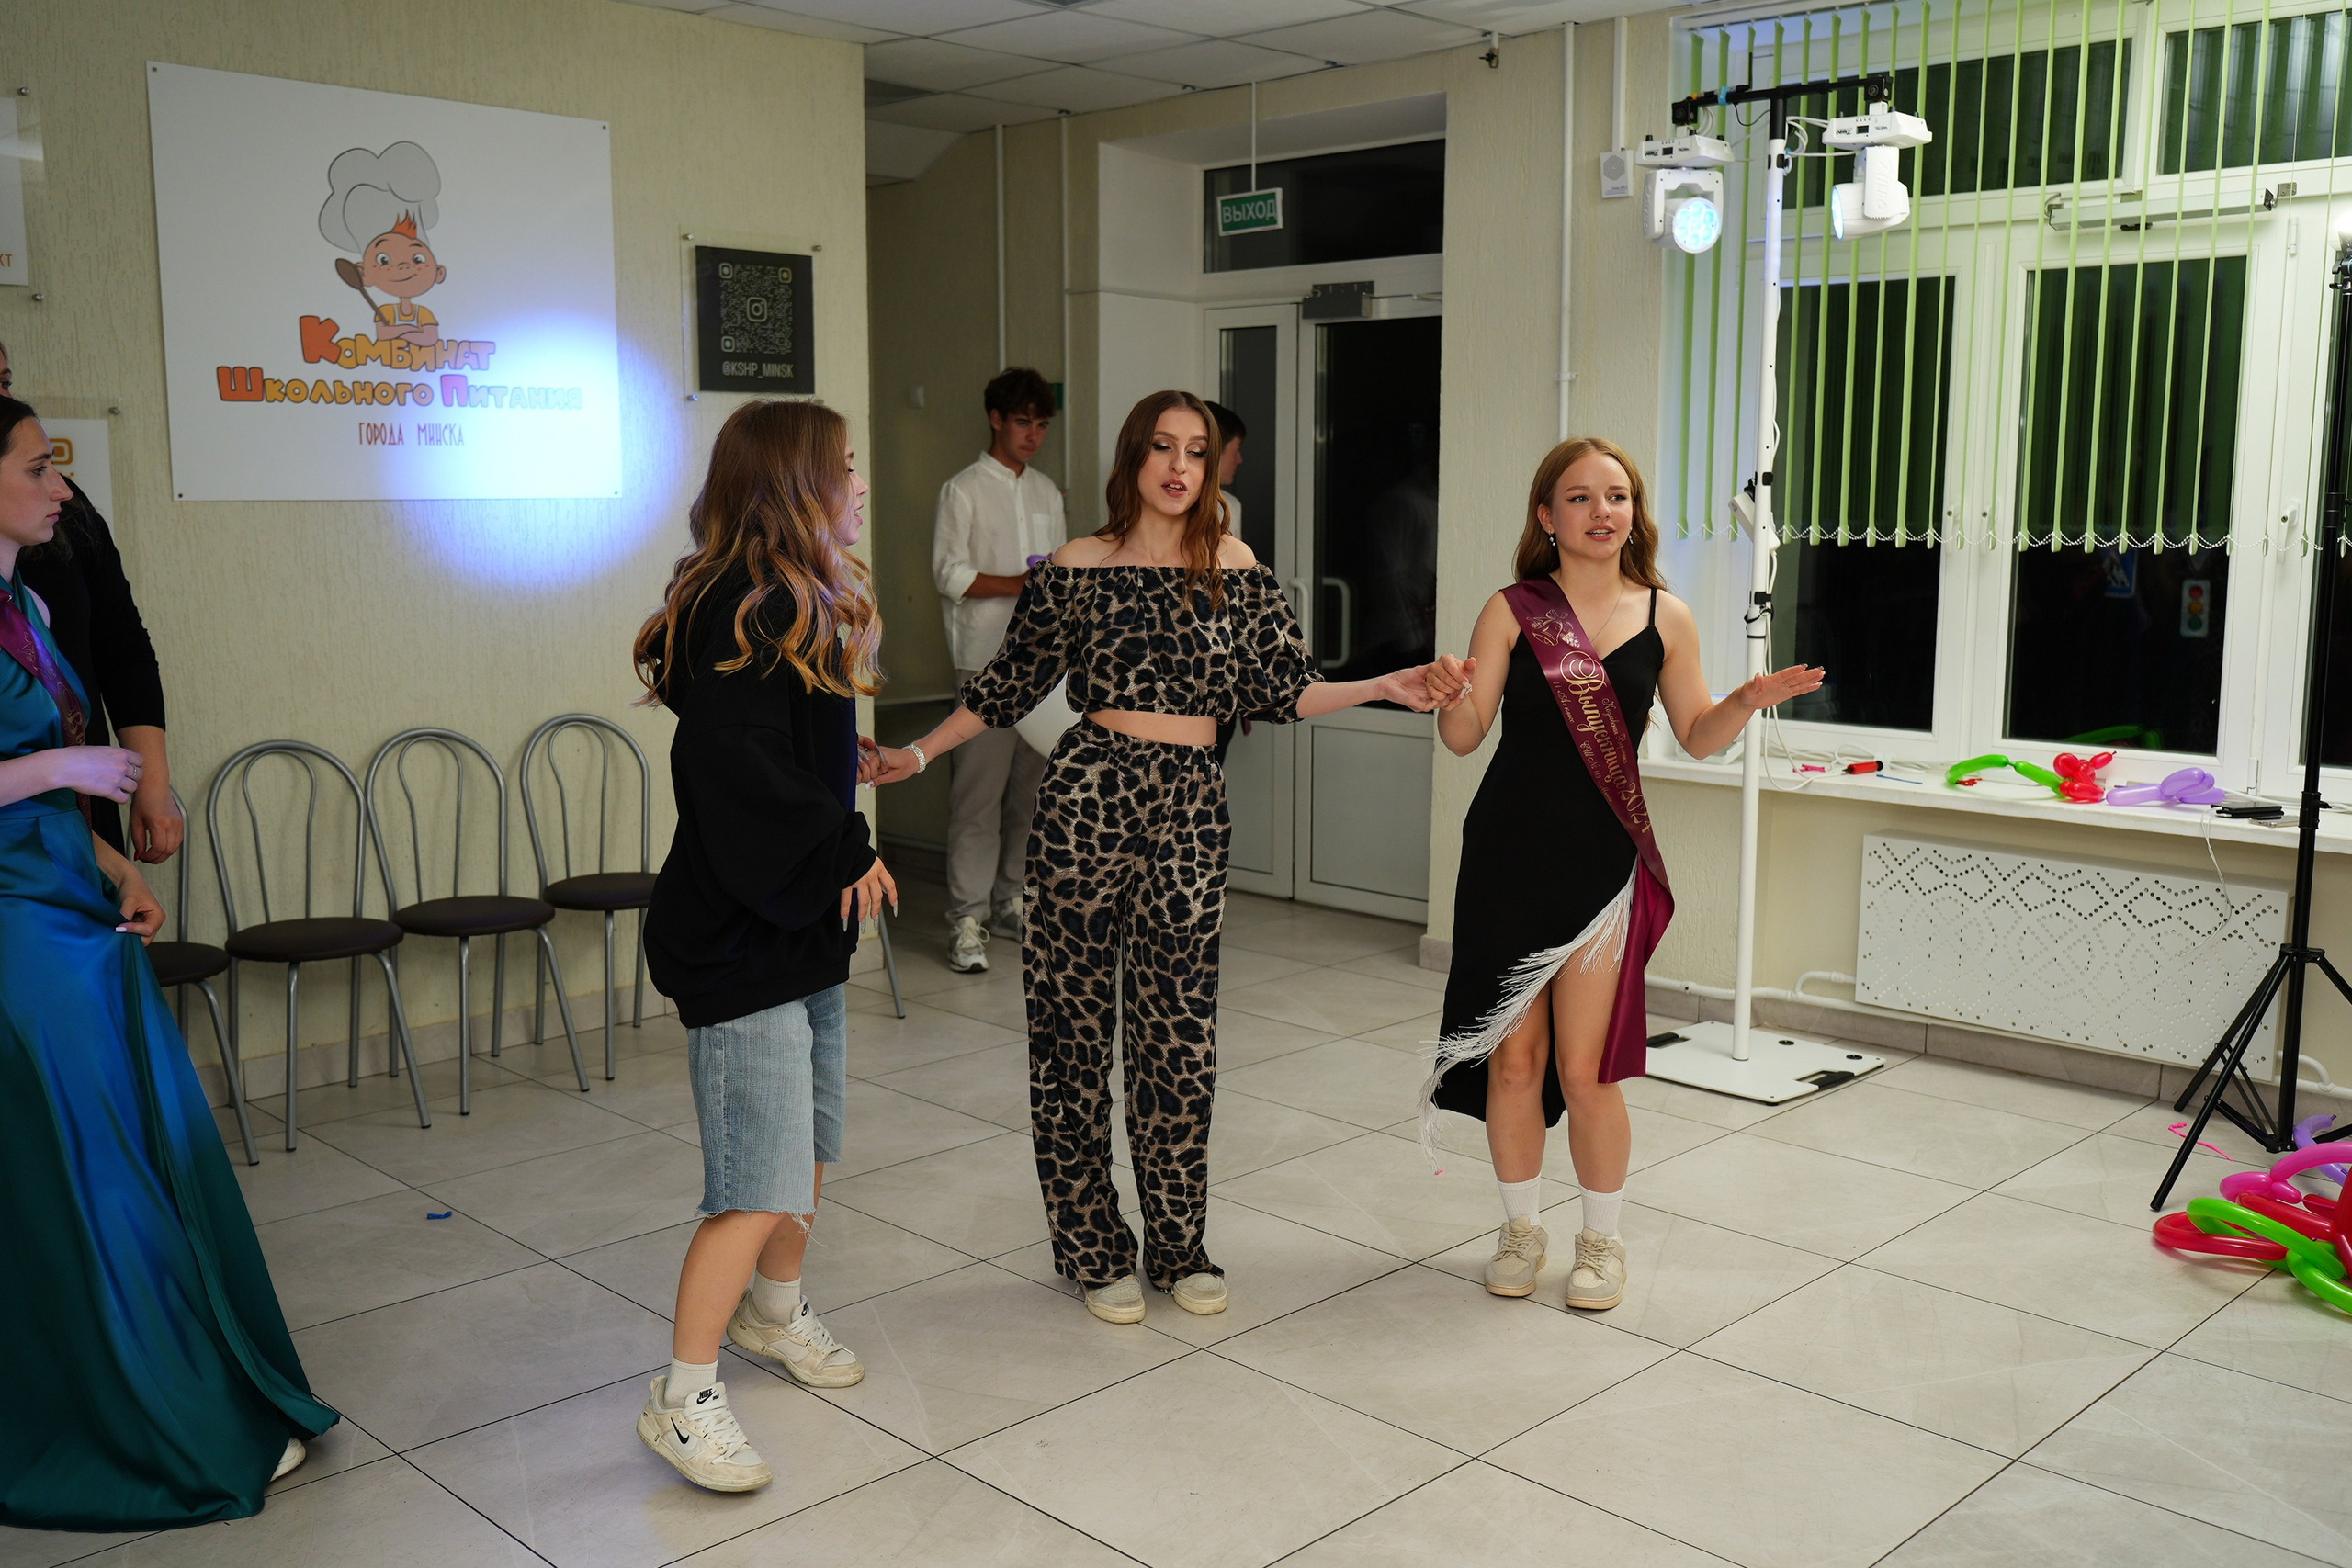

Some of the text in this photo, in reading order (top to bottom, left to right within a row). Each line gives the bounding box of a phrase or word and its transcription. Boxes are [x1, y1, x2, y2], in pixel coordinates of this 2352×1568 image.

[1223, 199, 1277, 223] ВЫХОД
[722, 360, 794, 378] @KSHP_MINSK
[359, 423, 464, 446] ГОРОДА МИНСКА
[1560, 650, 1651, 834] Выпускница 2024
[698, 1388, 713, 1399] NIKE
